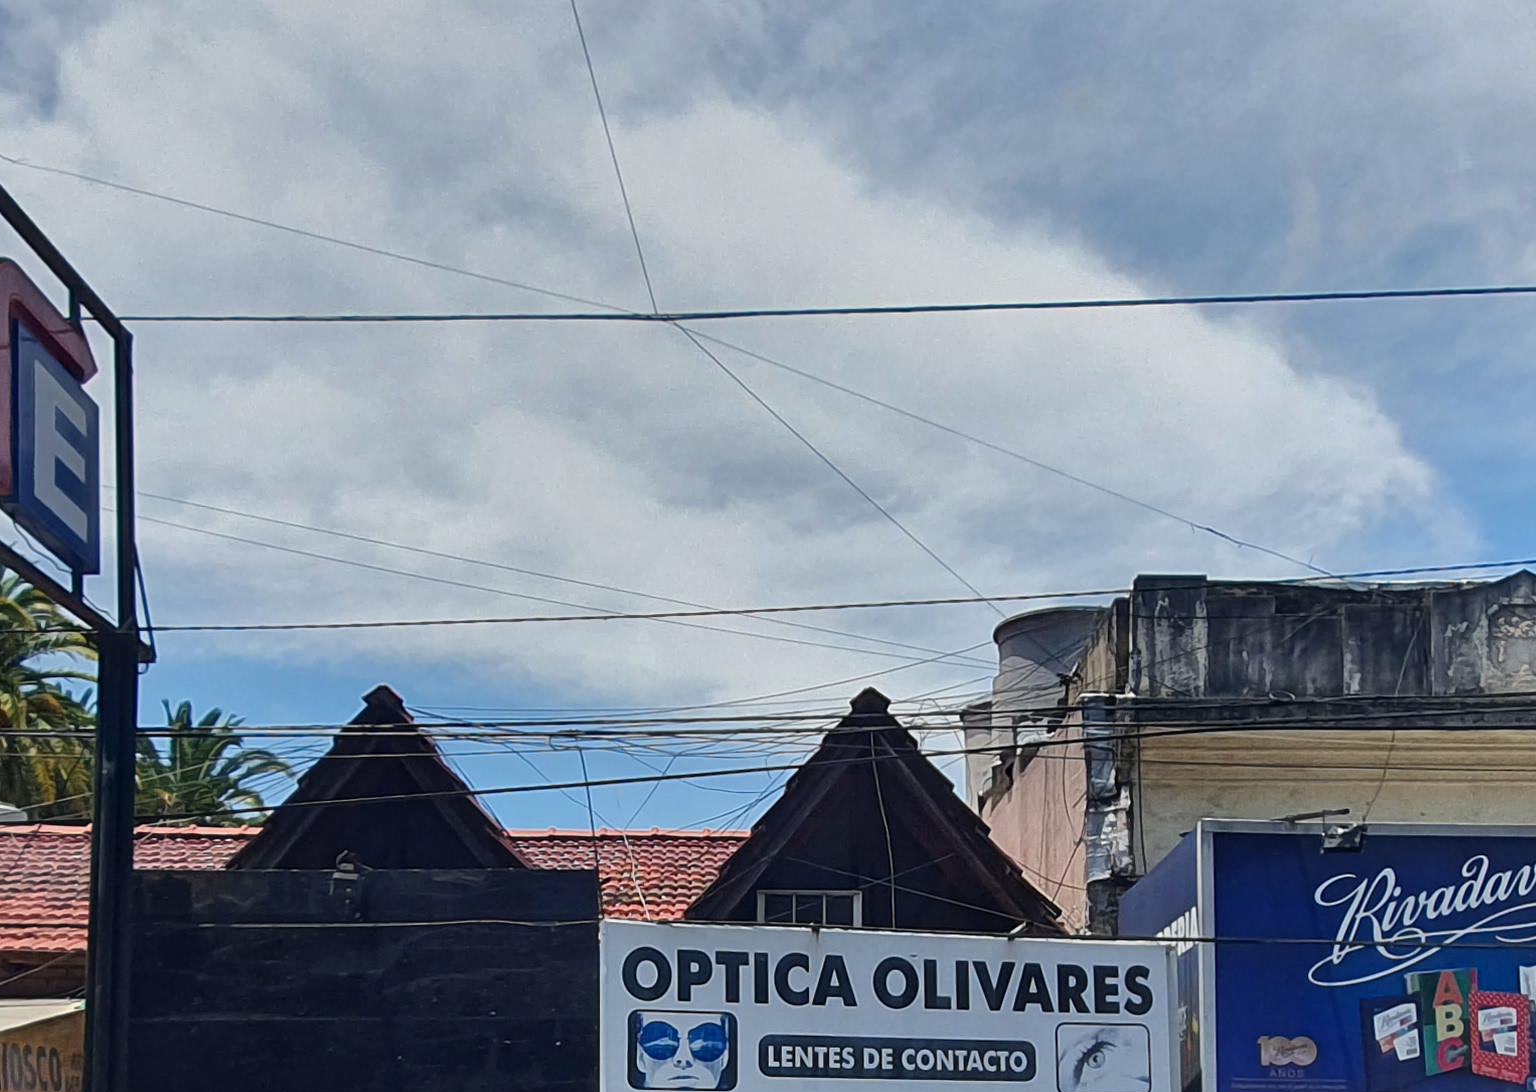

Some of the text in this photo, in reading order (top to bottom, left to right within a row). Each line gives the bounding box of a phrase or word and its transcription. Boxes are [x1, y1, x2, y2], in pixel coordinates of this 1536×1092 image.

[34, 360, 88, 544] E
[621, 946, 1154, 1015] OPTICA OLIVARES
[767, 1044, 1029, 1074] LENTES DE CONTACTO
